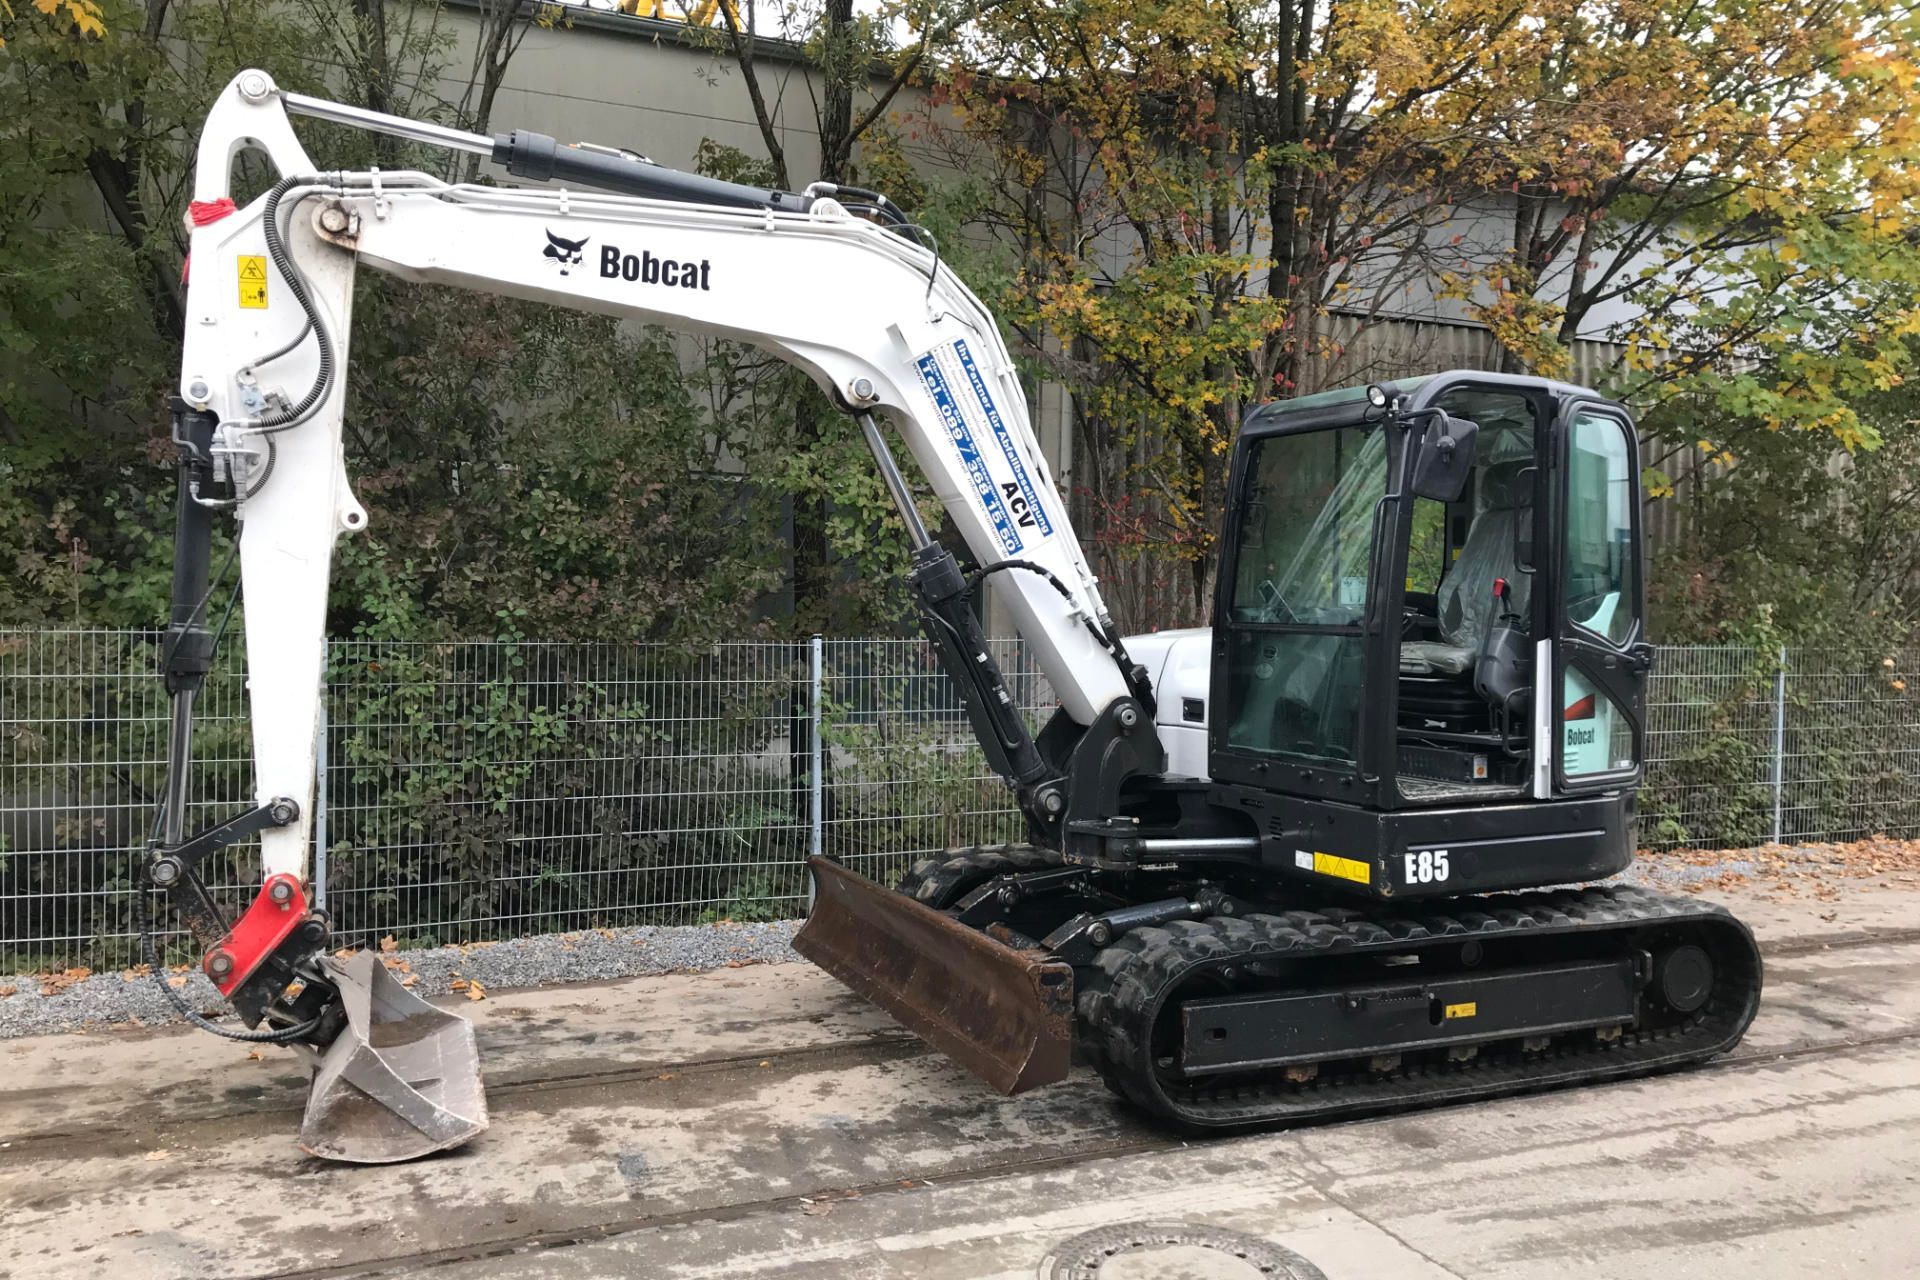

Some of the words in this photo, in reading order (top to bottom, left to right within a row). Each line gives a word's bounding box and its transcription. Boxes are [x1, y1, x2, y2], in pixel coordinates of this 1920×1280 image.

[600, 245, 710, 291] Bobcat
[953, 409, 962, 424] Sie
[960, 425, 971, 441] uns
[957, 343, 970, 362] Ihr
[966, 365, 990, 409] Partner
[988, 410, 1001, 429] für
[996, 431, 1050, 534] Abfallbeseitigung
[922, 361, 942, 399] Tel.
[941, 404, 963, 440] 089
[959, 446, 971, 454] /
[967, 461, 989, 496] 368
[987, 501, 1003, 524] 15
[999, 528, 1017, 552] 50
[1001, 482, 1035, 529] ACV
[1567, 728, 1595, 746] Bobcat
[1404, 850, 1450, 885] E85
